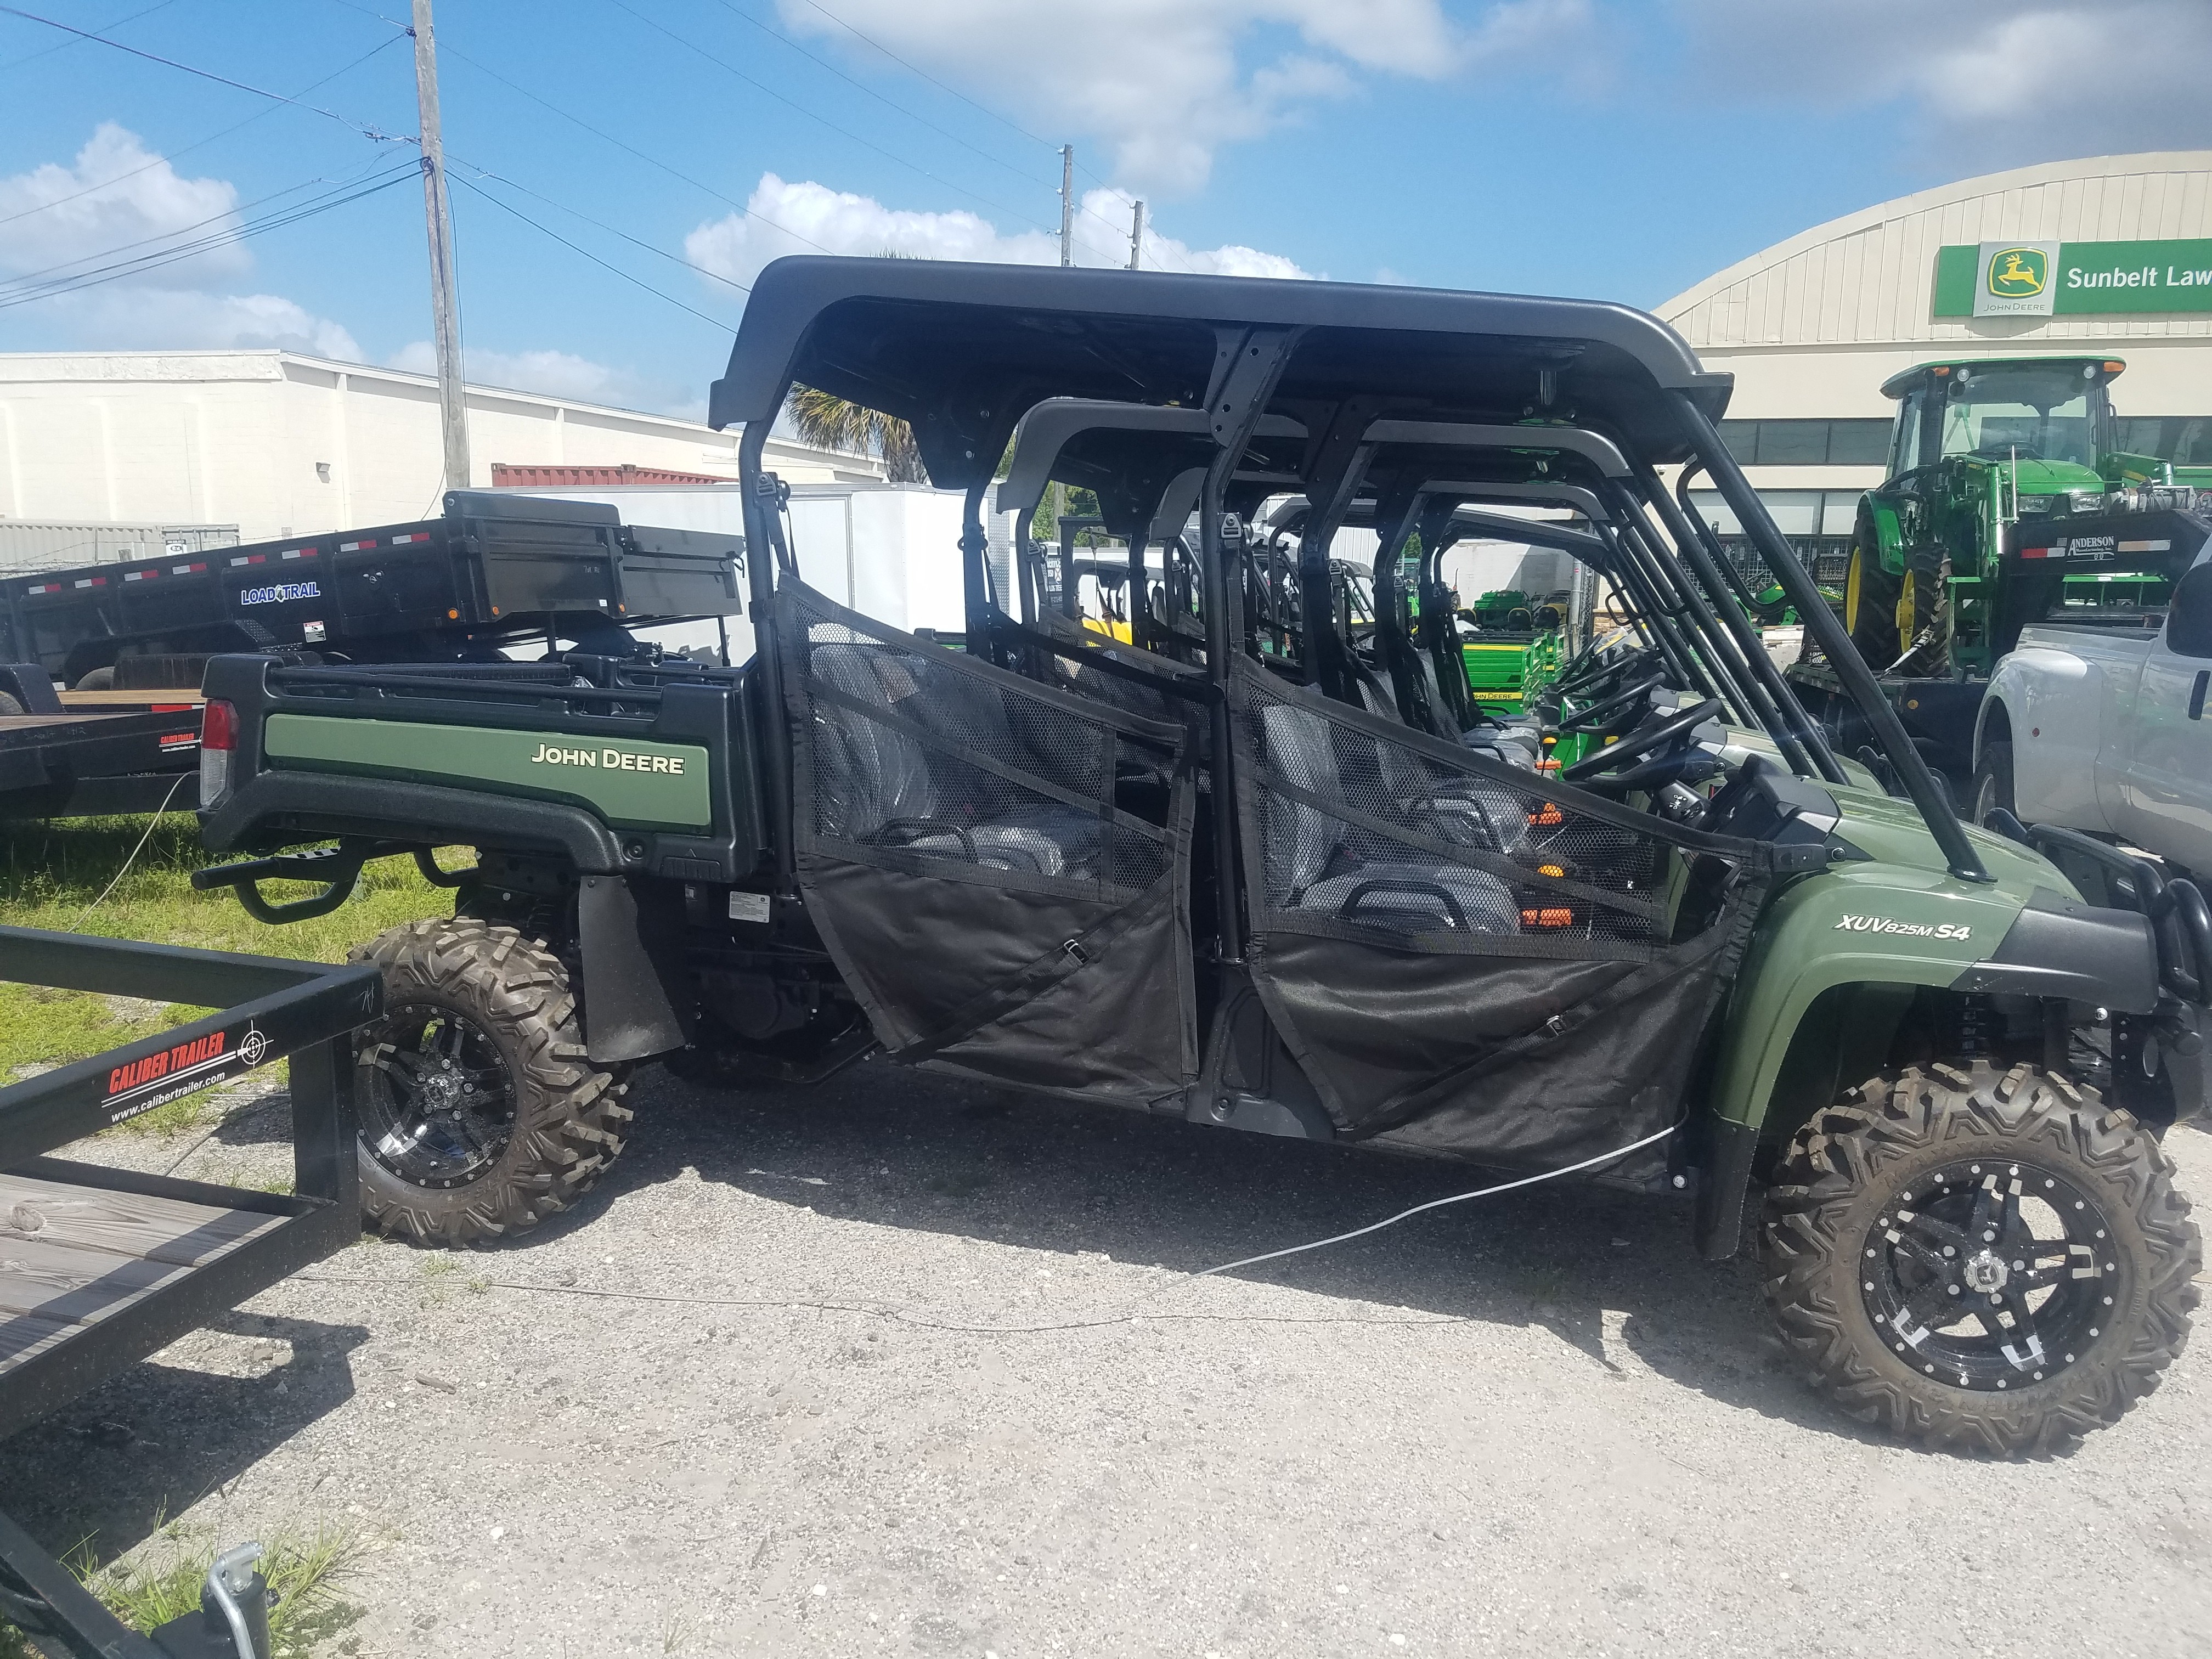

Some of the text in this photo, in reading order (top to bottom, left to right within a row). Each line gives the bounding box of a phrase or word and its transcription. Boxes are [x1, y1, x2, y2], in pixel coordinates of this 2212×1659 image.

[2067, 267, 2158, 288] Sunbelt
[2067, 535, 2114, 556] ANDERSON
[241, 582, 321, 605] LOAD TRAIL
[531, 743, 685, 775] JOHN DEERE
[1933, 923, 1973, 941] S4
[109, 1031, 225, 1094] CALIBER TRAILER
[111, 1071, 225, 1123] www.calibertrailer.com
